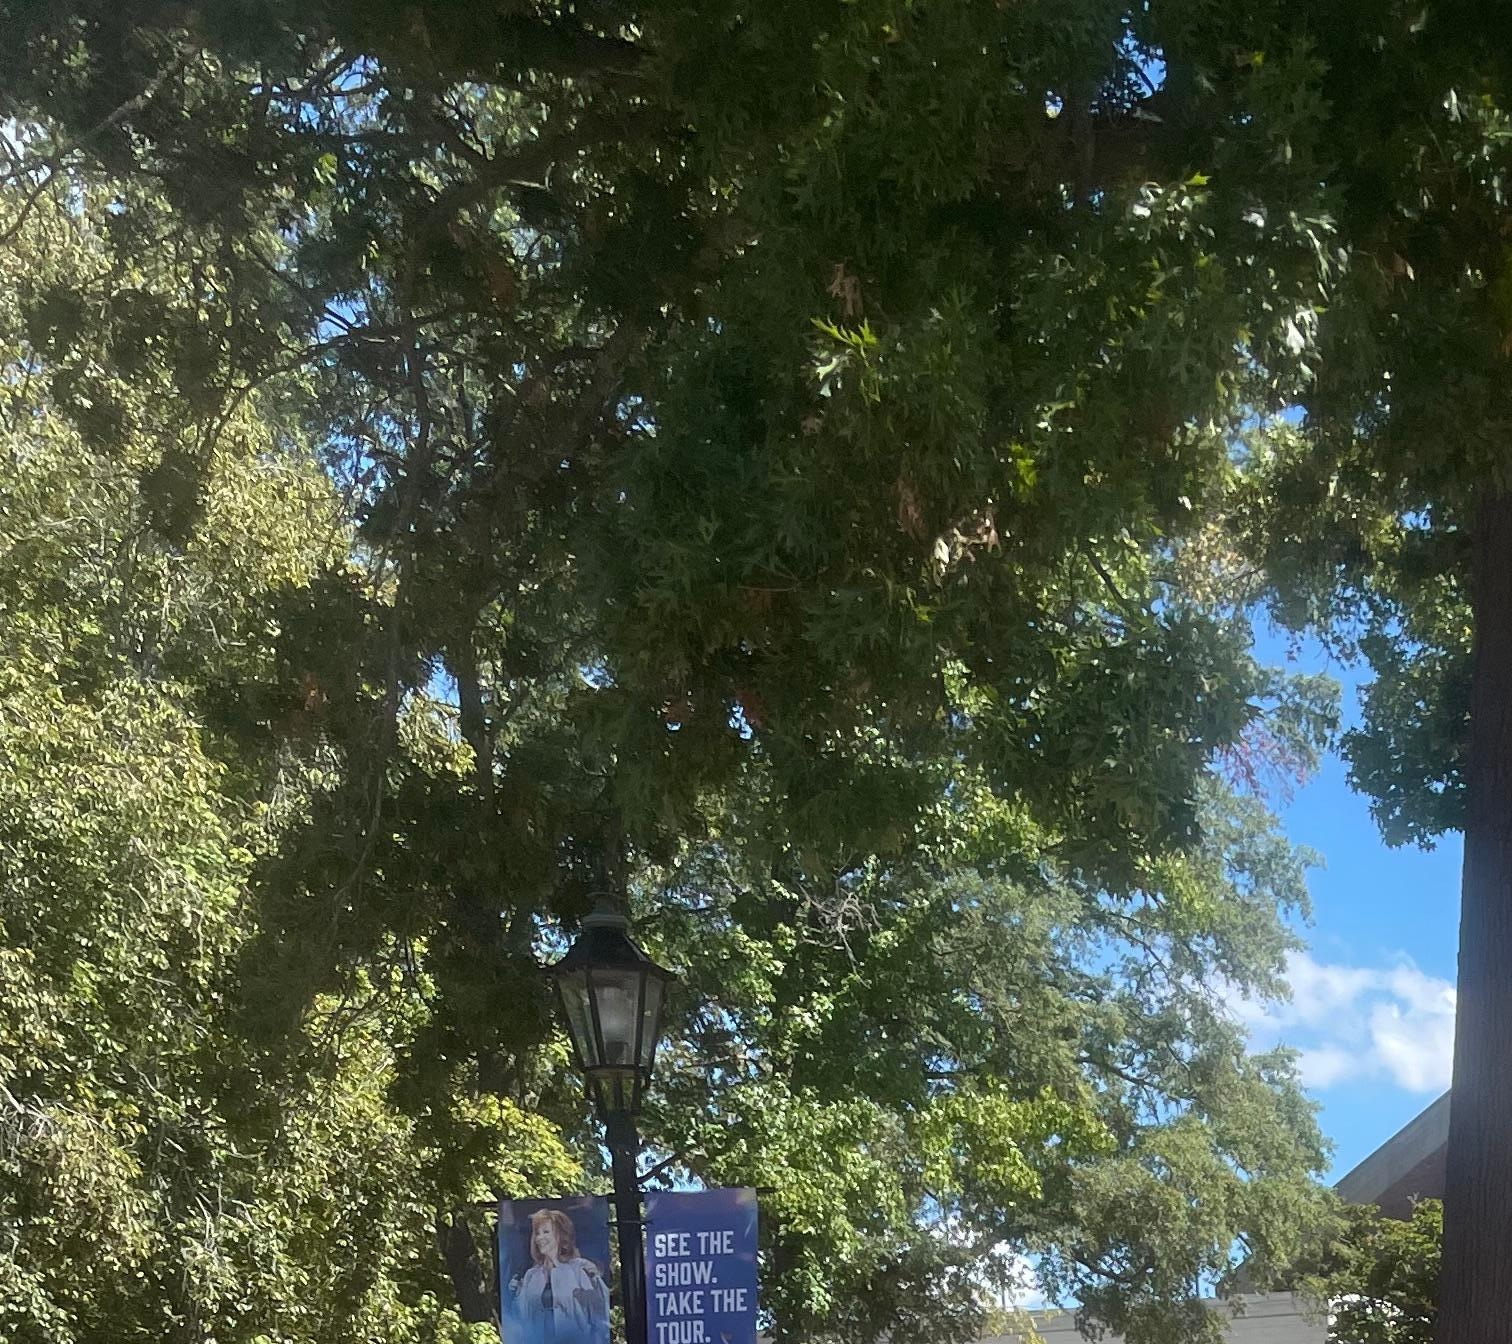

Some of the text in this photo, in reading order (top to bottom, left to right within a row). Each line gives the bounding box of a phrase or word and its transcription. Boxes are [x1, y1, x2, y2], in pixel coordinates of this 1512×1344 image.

[655, 1231, 734, 1257] SEE THE
[655, 1261, 717, 1287] SHOW.
[656, 1289, 748, 1316] TAKE THE
